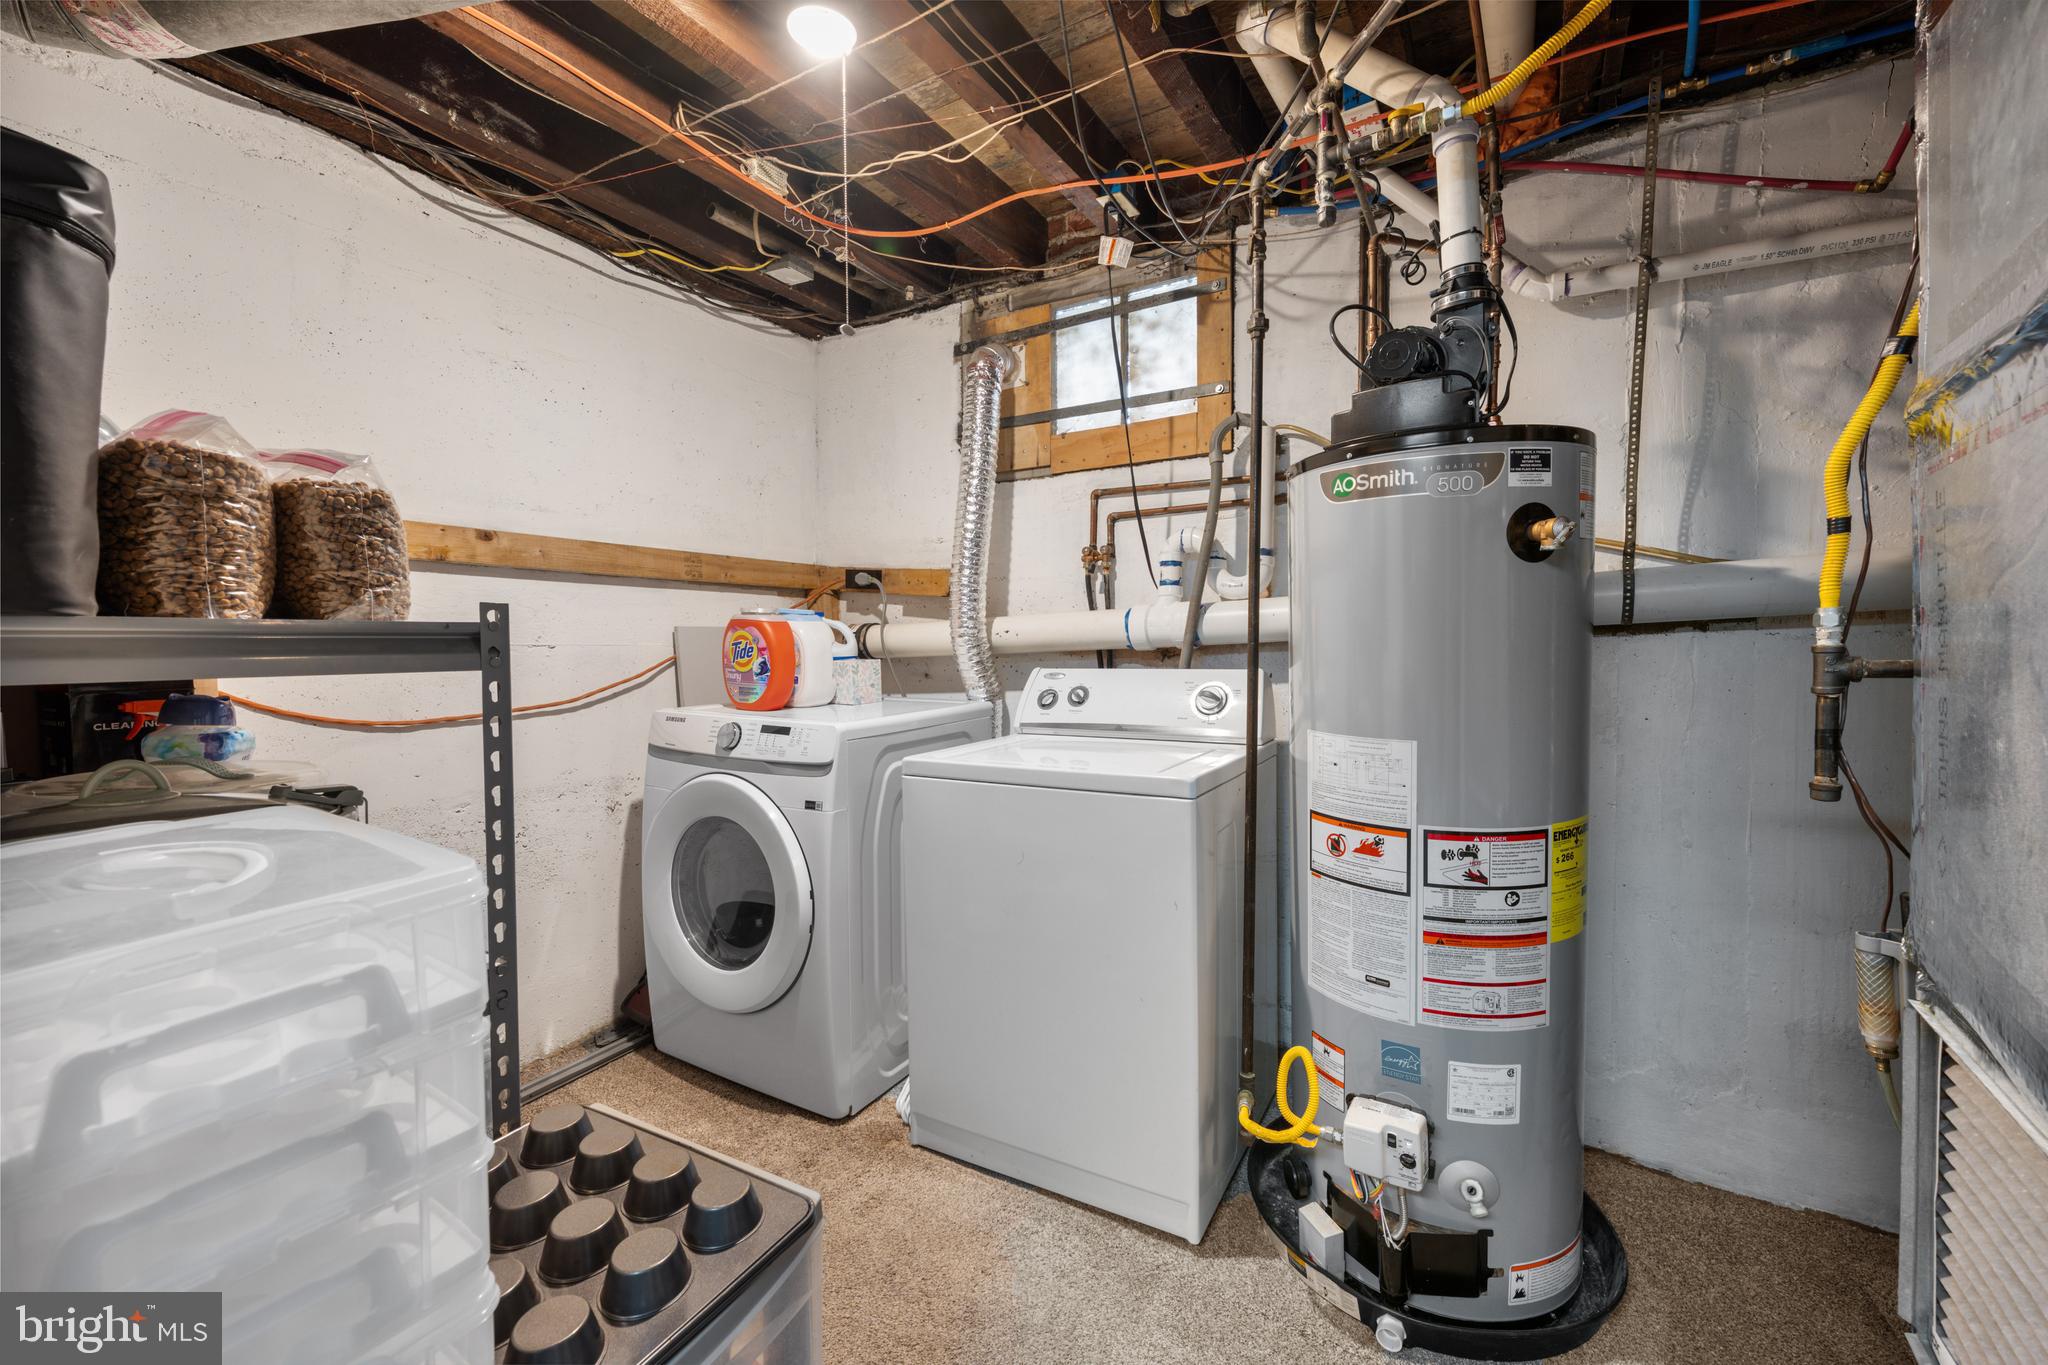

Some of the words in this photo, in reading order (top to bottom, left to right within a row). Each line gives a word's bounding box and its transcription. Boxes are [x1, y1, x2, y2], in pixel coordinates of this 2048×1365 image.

[1711, 259, 1733, 269] EAGLE
[1799, 246, 1815, 255] DWV
[1422, 462, 1488, 472] SIGNATURE
[1437, 475, 1473, 493] 500
[732, 641, 754, 664] Tide
[93, 720, 160, 731] CLEAN
